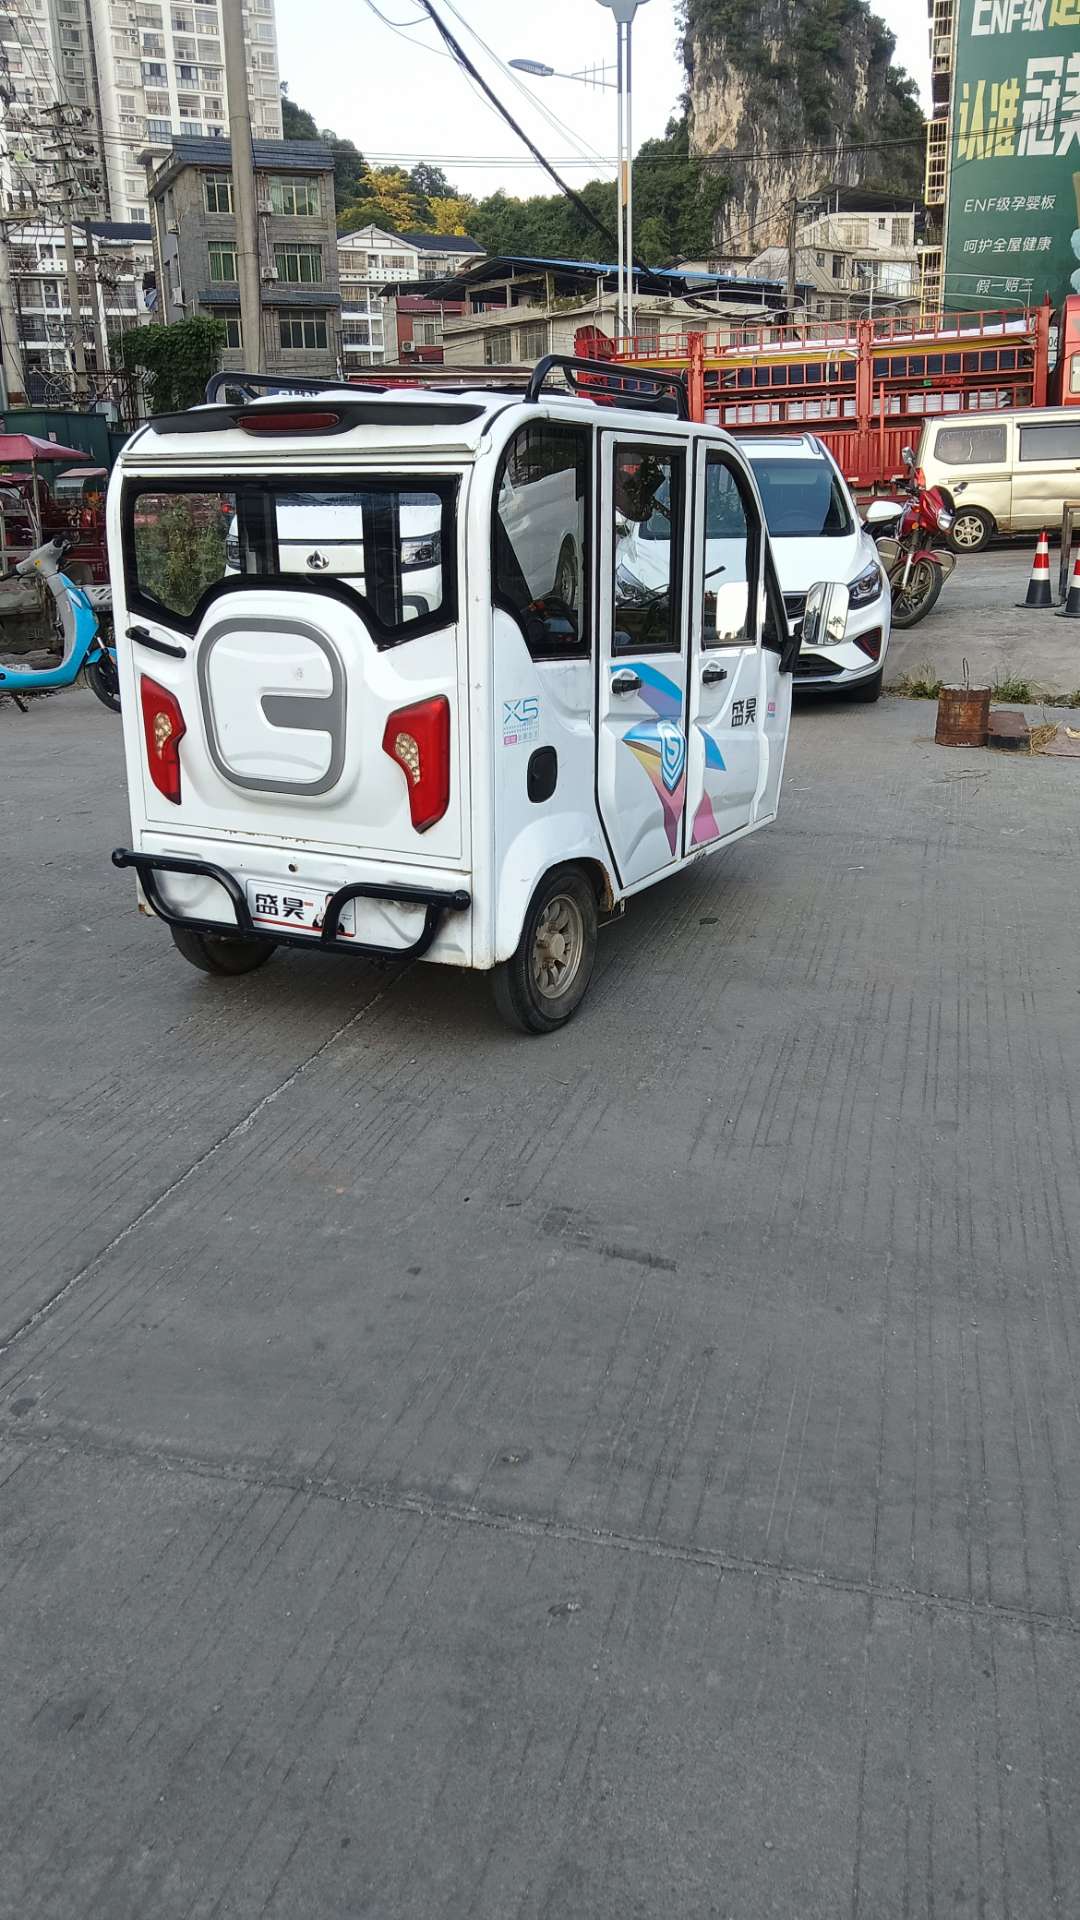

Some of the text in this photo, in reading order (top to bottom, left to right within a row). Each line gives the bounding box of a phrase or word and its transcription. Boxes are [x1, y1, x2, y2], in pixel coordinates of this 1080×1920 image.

[963, 194, 1057, 213] ENF级孕婴板
[963, 236, 1053, 254] 呵护全屋健康
[503, 697, 539, 724] X5
[731, 697, 757, 728] 盛昊
[255, 893, 304, 920] 盛昊
